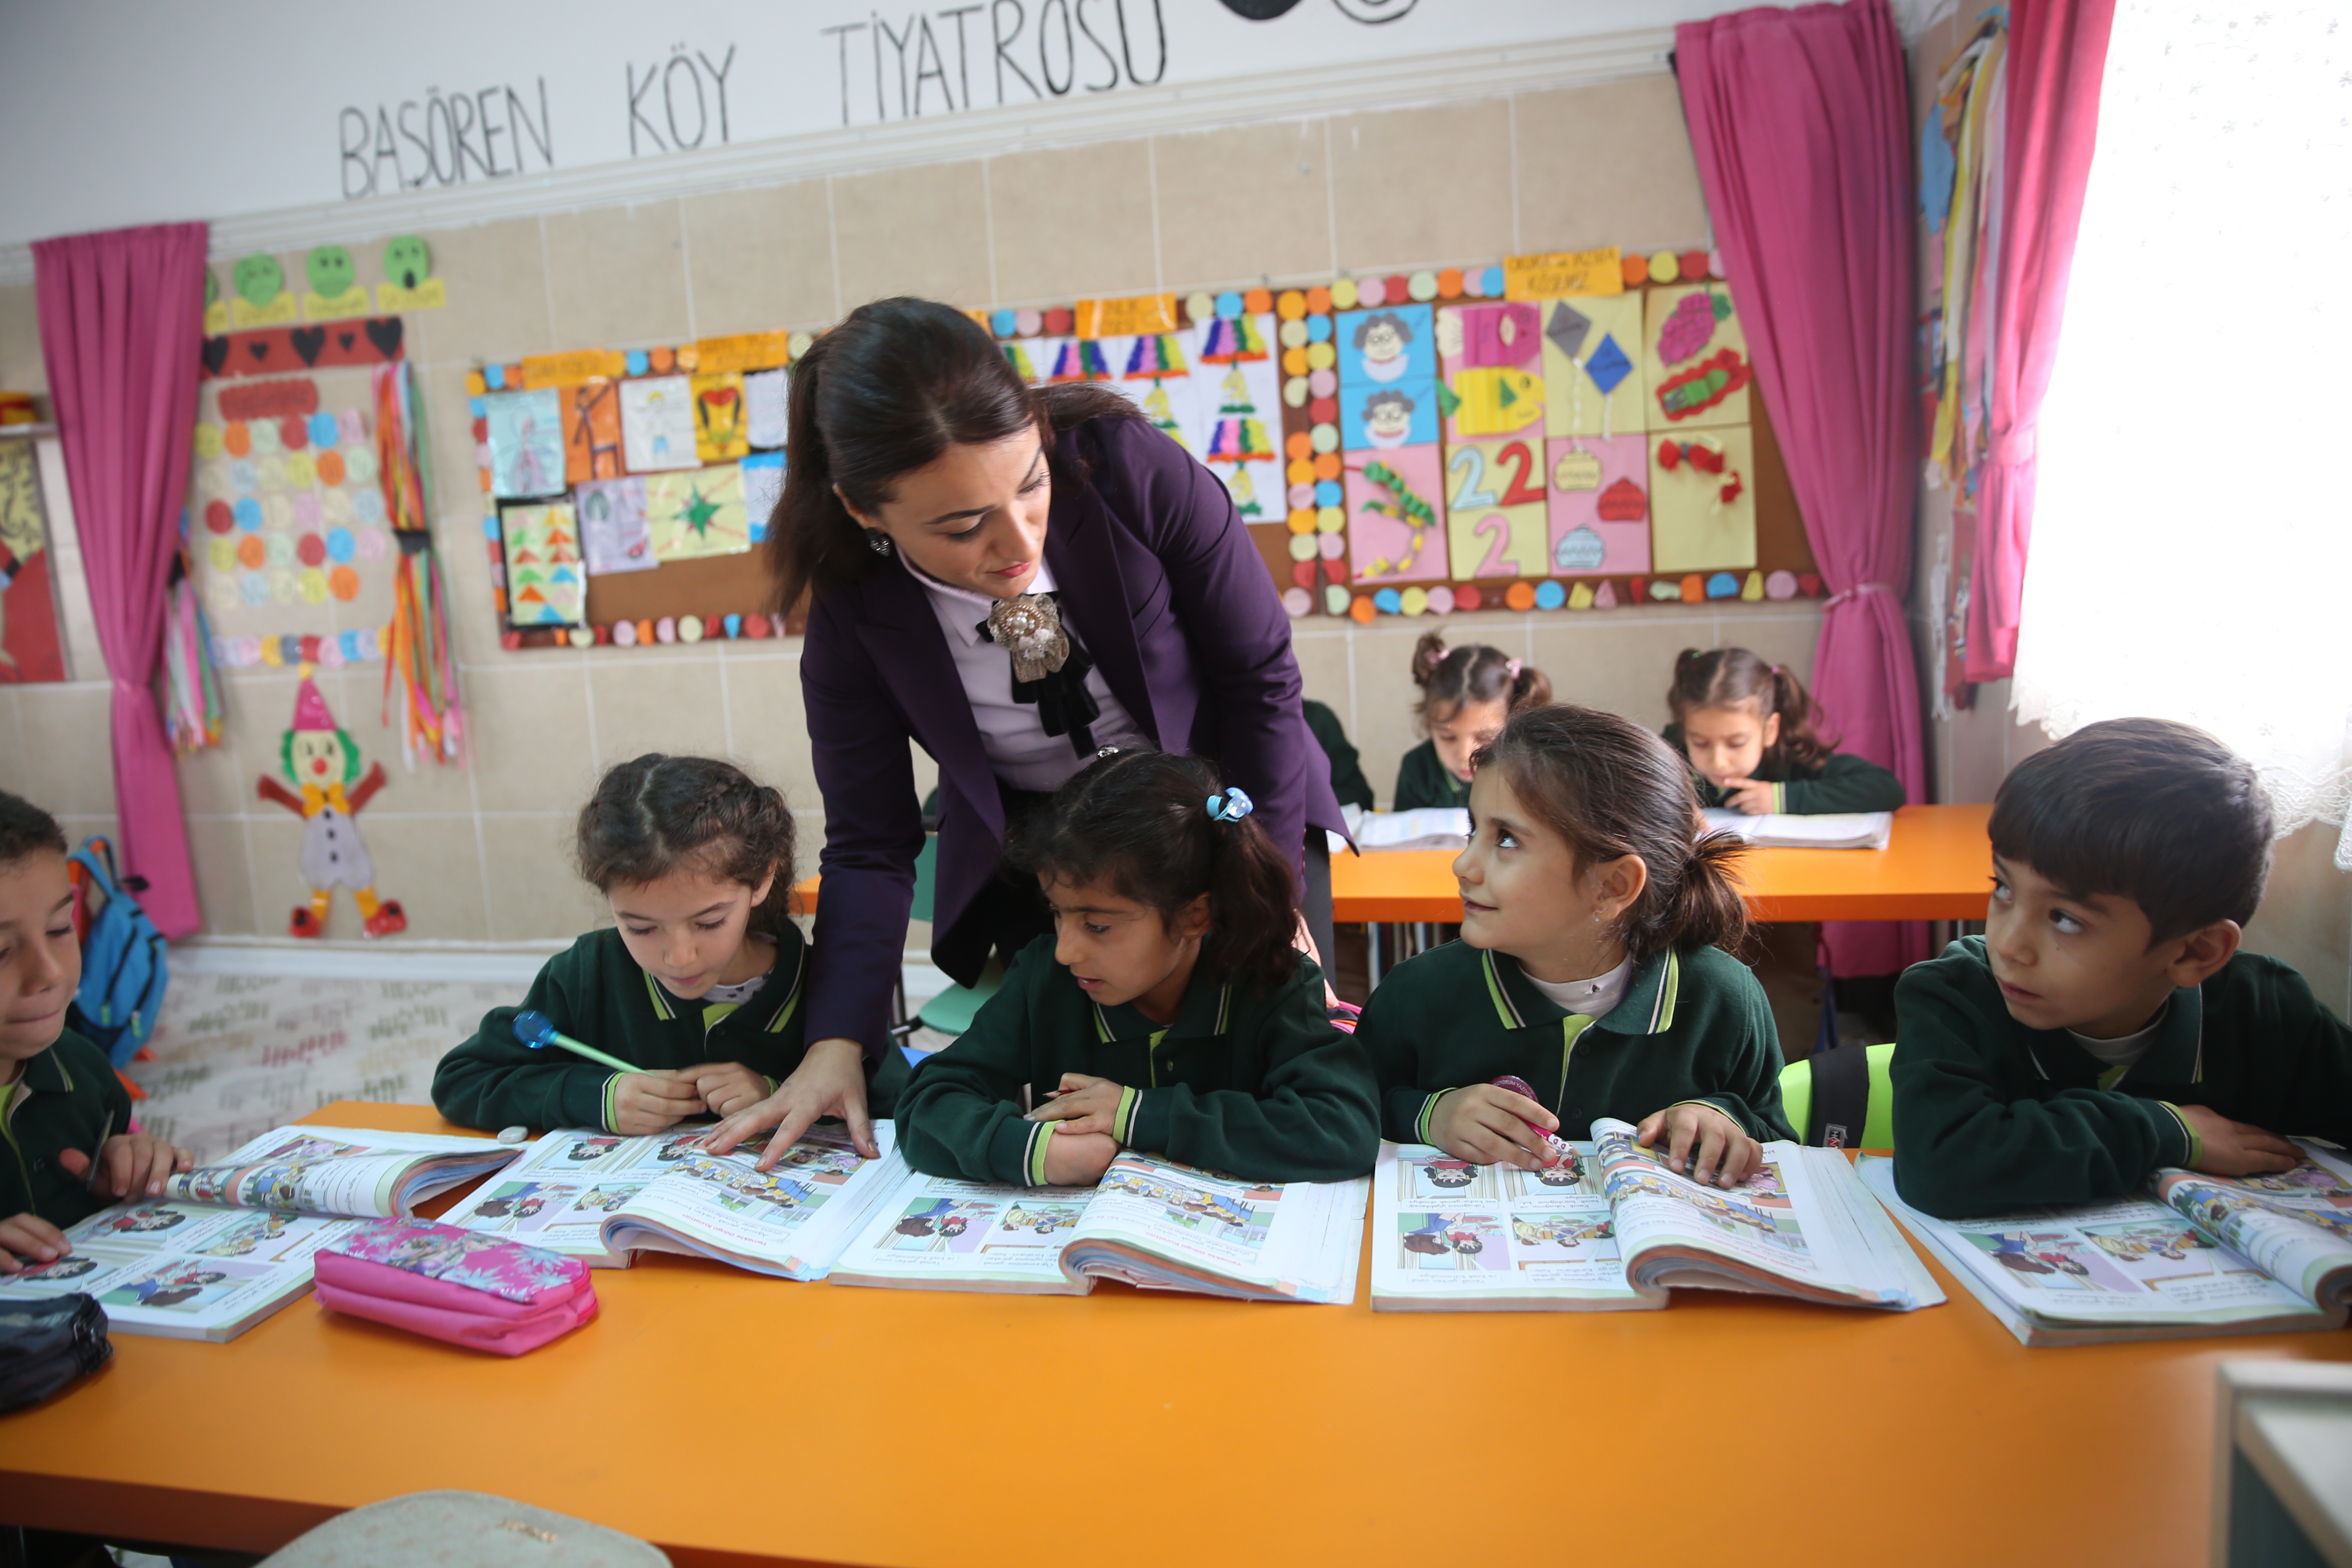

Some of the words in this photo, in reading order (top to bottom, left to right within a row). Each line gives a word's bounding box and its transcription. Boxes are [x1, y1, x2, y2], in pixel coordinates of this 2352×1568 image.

[625, 41, 736, 156] KÖY
[819, 0, 1166, 127] TİYATROSU
[1207, 1253, 1242, 1267] Yemekte
